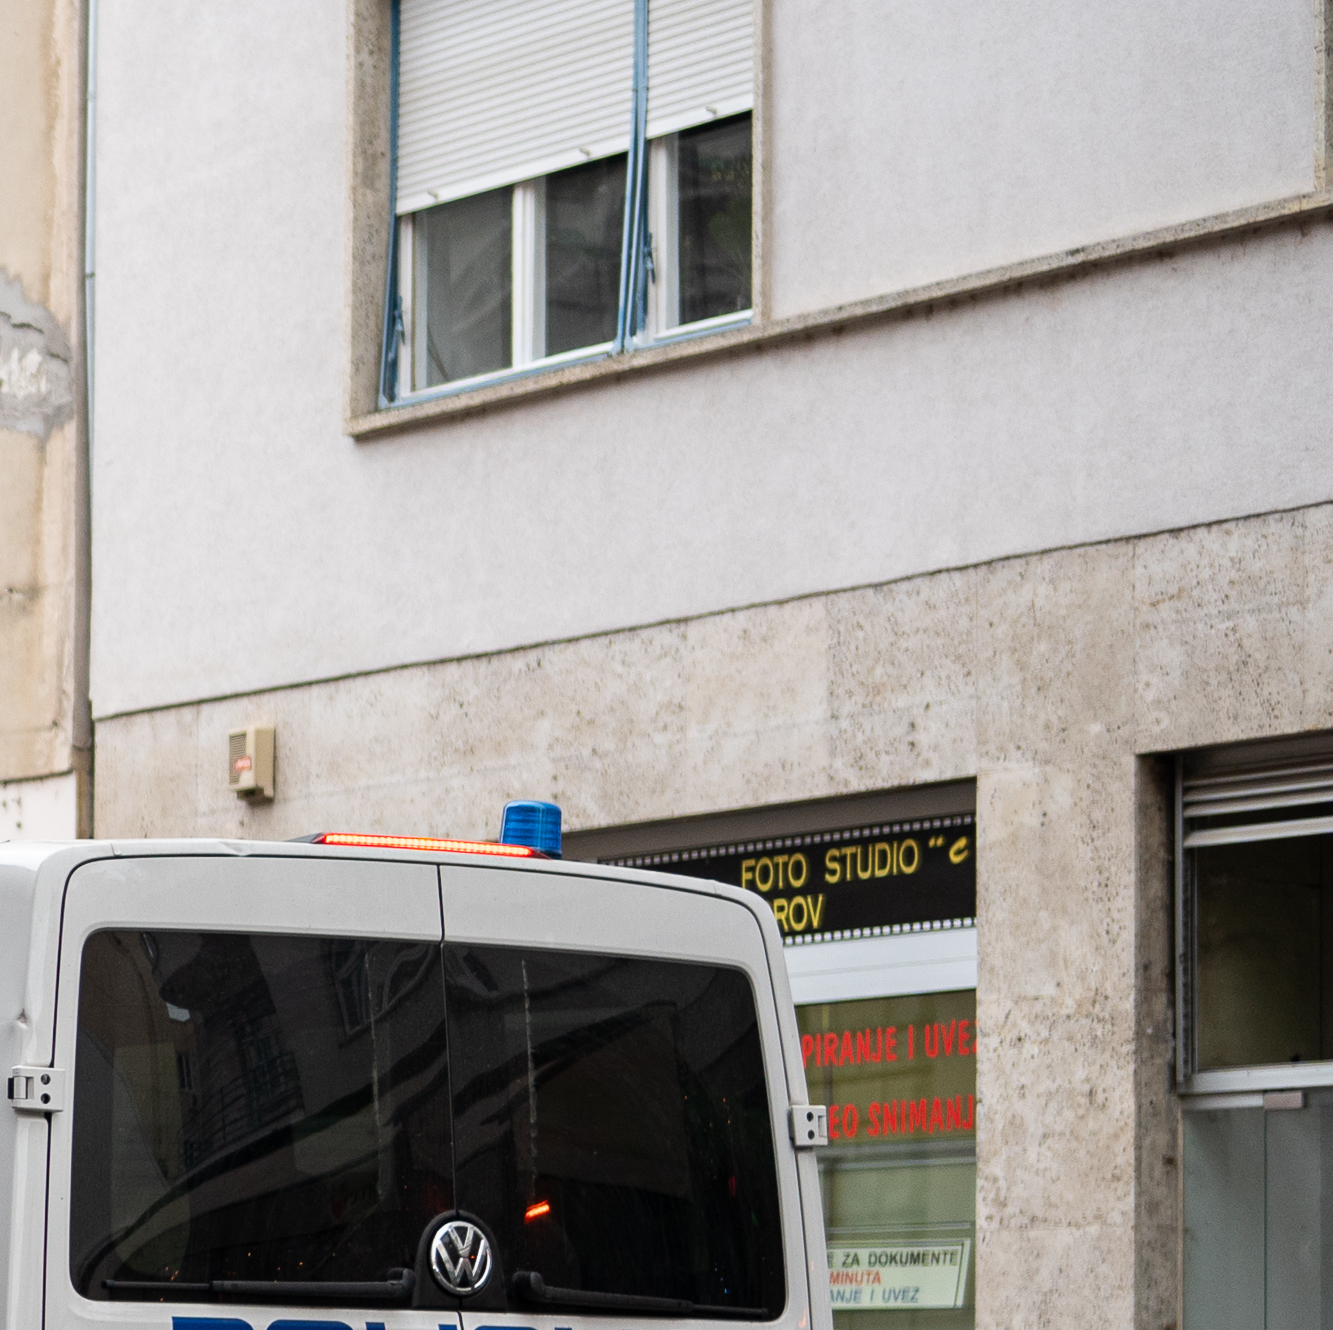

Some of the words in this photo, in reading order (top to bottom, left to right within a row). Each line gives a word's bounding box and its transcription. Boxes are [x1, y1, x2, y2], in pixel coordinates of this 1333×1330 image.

[741, 853, 807, 892] FOTO
[825, 838, 919, 883] STUDIO
[801, 1026, 897, 1069] PIRANJE
[908, 1024, 914, 1060] I
[924, 1018, 977, 1058] UVE
[867, 1094, 974, 1137] SNIMANJ
[842, 1251, 860, 1268] ZA
[868, 1249, 958, 1267] DOKUMENTE
[829, 1270, 882, 1286] MINUTA
[882, 1286, 920, 1303] UVEZ
